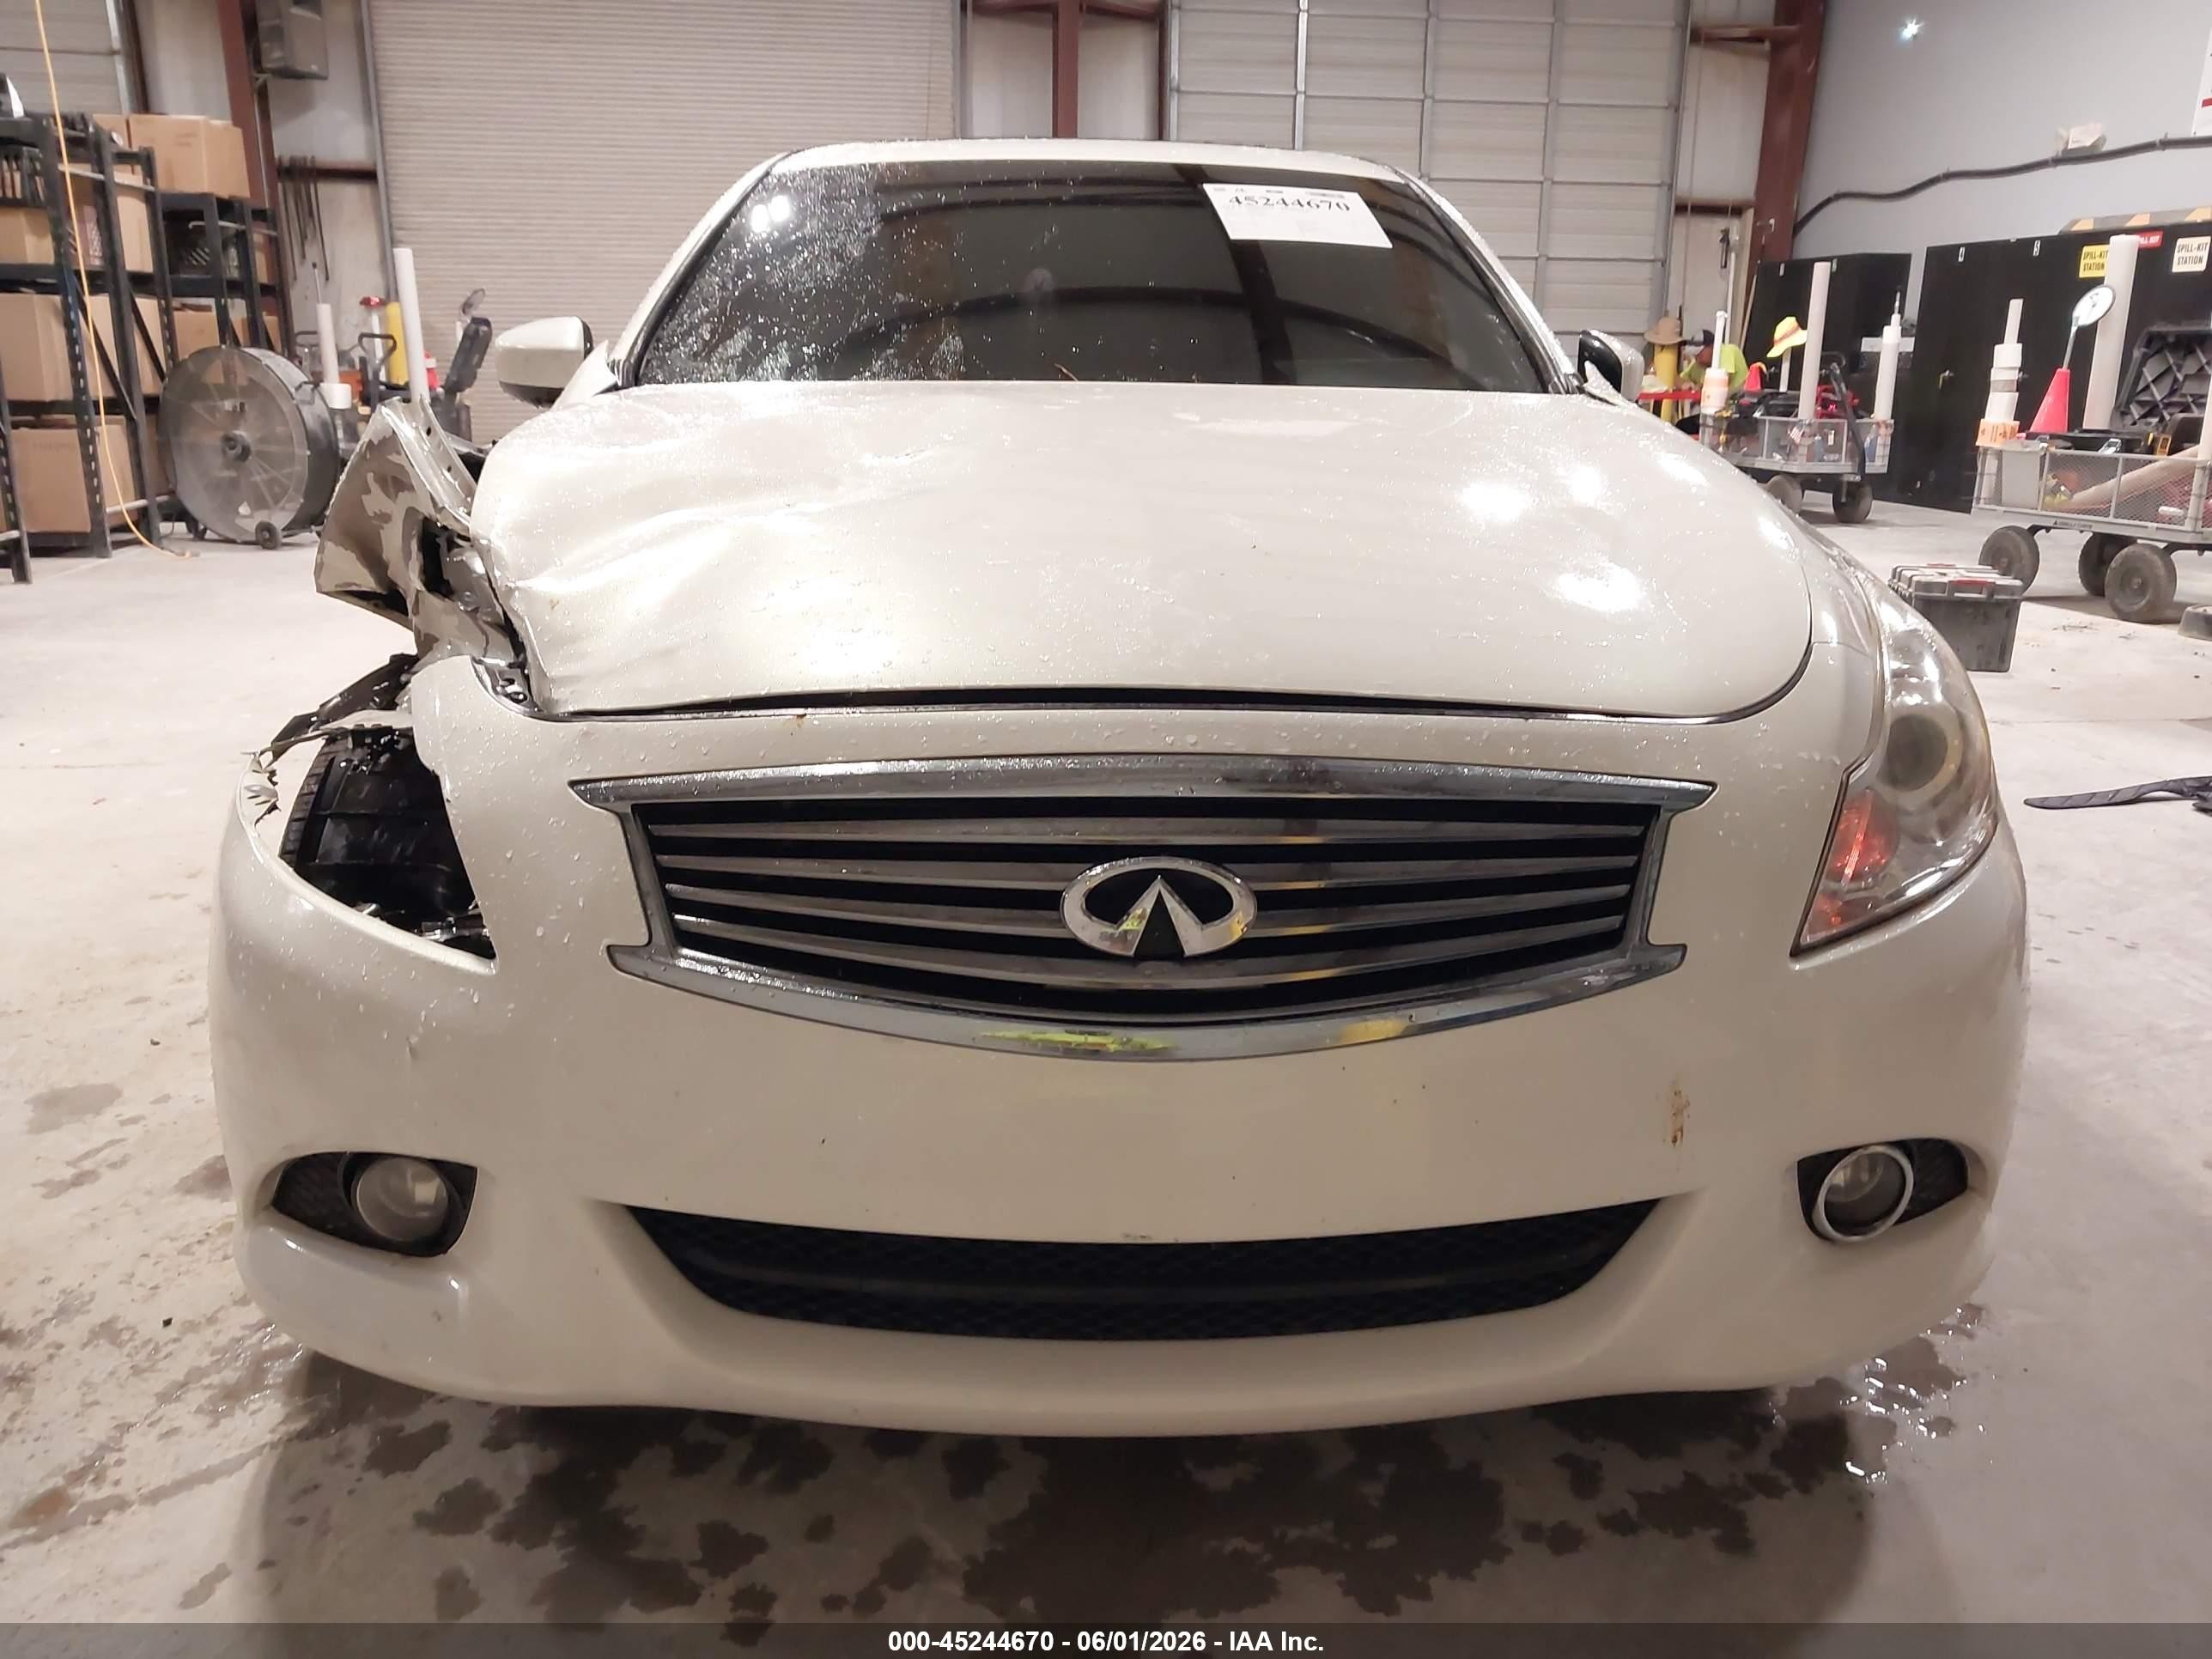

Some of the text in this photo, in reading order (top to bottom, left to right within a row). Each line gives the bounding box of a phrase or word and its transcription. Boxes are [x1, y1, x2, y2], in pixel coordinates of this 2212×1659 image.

[1229, 196, 1351, 212] 45244670
[2177, 242, 2209, 254] SPILL-KIT
[2083, 250, 2109, 261] SPILL-KIT
[2177, 255, 2203, 266] STATION
[2083, 262, 2105, 272] STATION
